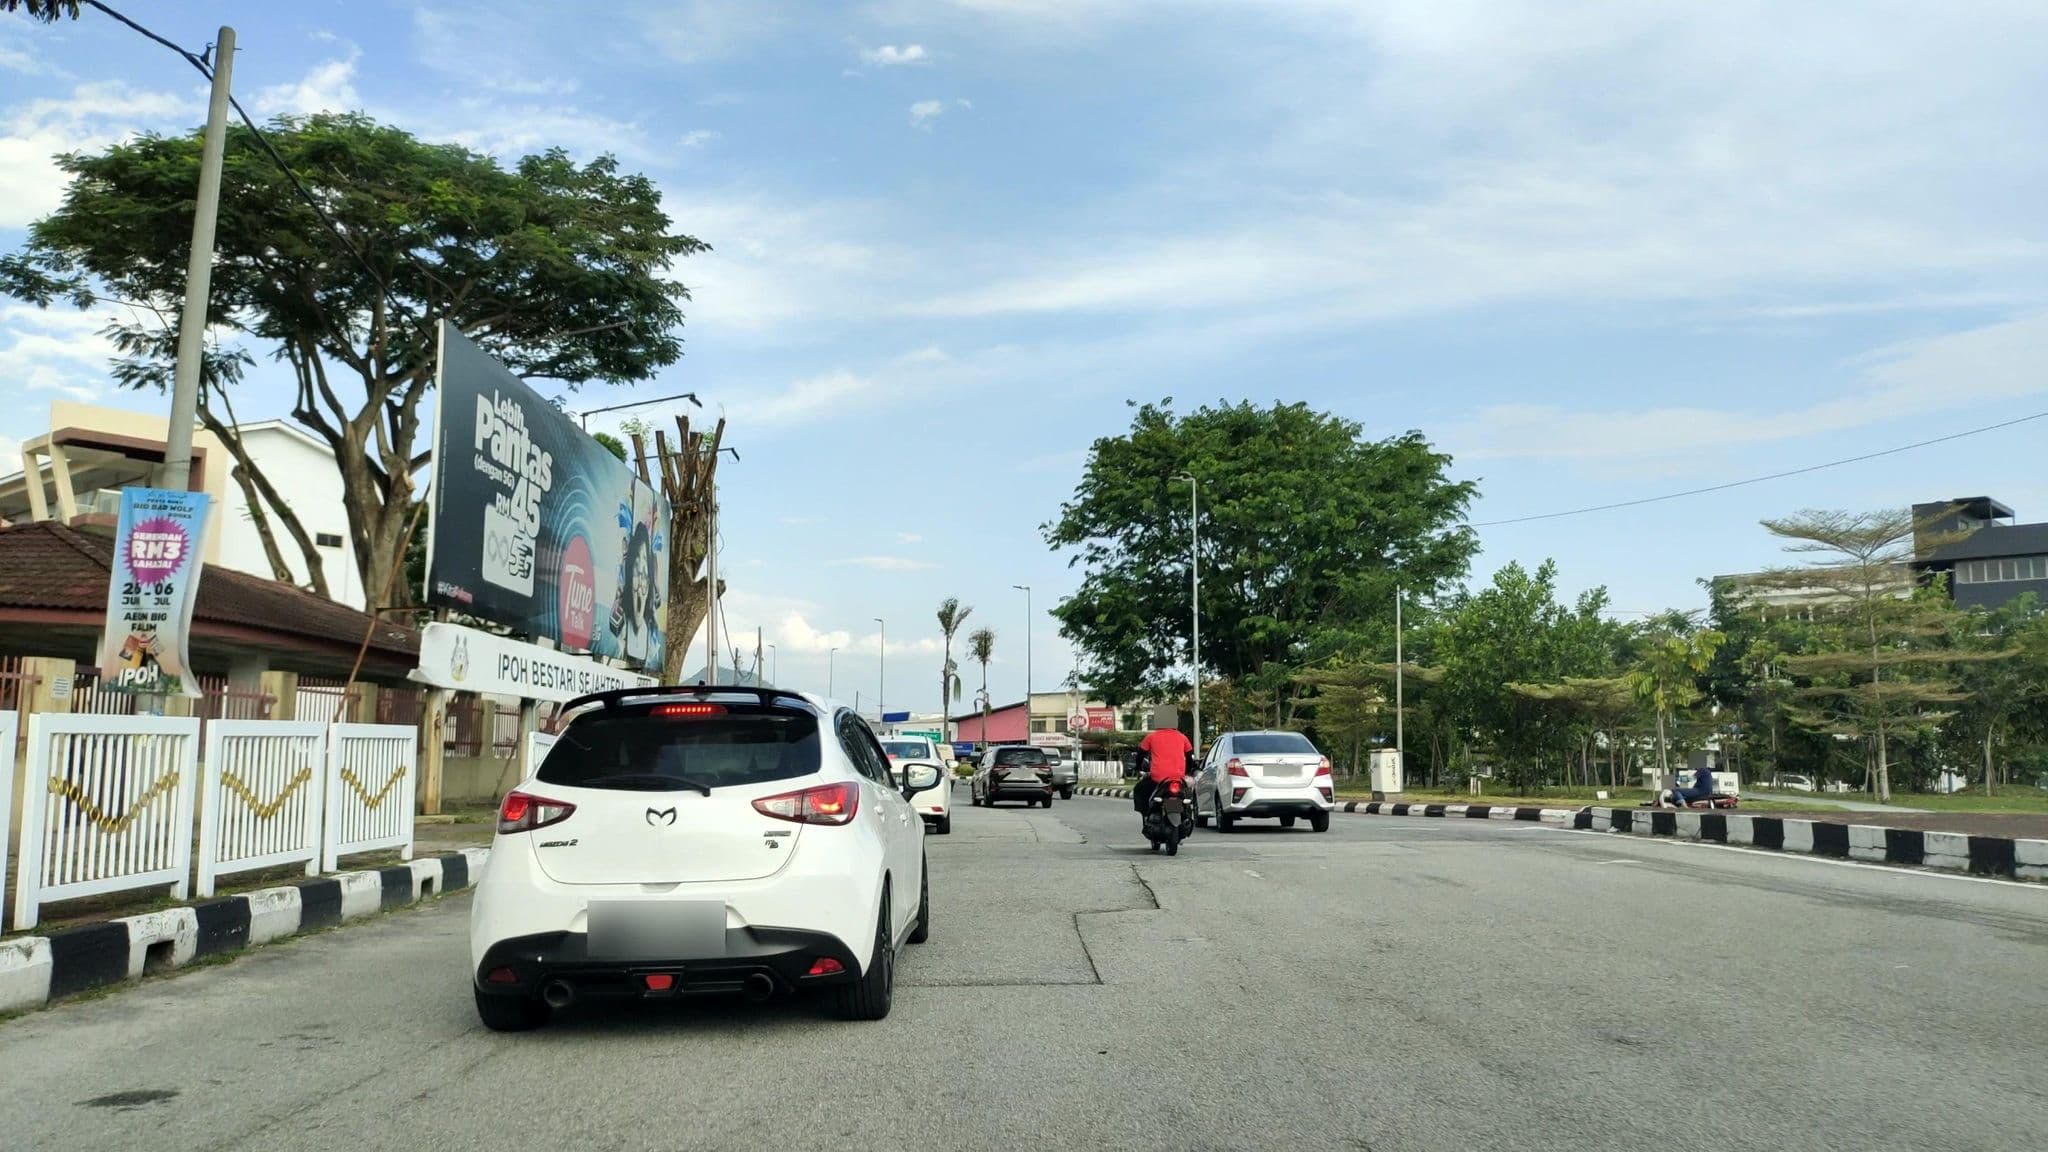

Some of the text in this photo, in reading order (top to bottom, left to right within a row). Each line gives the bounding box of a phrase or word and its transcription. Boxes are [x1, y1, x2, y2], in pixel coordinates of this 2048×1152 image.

[494, 388, 525, 432] Lebih
[475, 393, 553, 492] Pantas
[474, 453, 503, 482] (dengan
[496, 476, 542, 538] RM 45
[131, 540, 182, 560] RM3
[122, 582, 142, 596] 26
[154, 582, 174, 596] 06
[153, 597, 171, 606] JUL
[564, 563, 593, 619] Tune
[150, 612, 167, 621] BIG
[118, 664, 159, 687] IPOH
[498, 652, 529, 685] IPOH
[532, 661, 576, 692] BESTARI
[569, 838, 578, 846] 2
